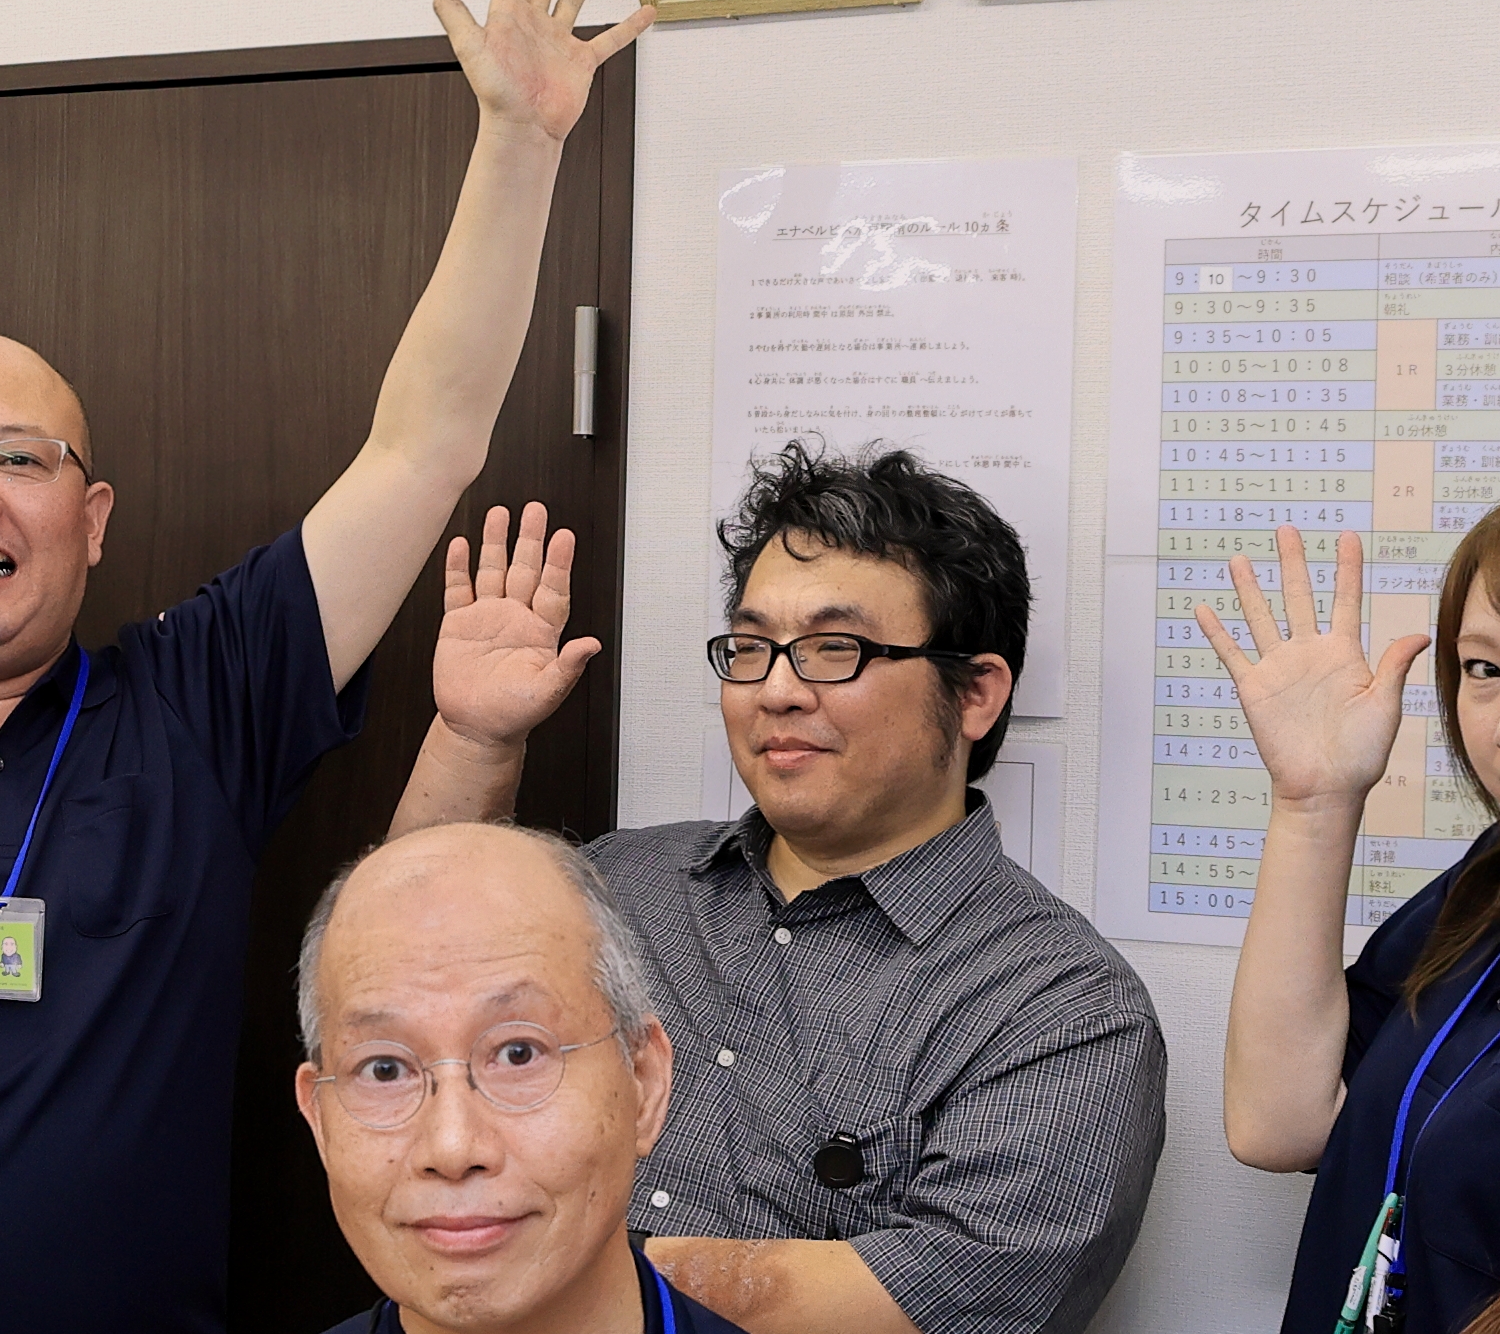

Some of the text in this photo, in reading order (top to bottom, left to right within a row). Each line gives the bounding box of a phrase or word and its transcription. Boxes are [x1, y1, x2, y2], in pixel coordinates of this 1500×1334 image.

[1257, 248, 1283, 261] 時間
[1384, 303, 1411, 316] 朝礼
[1445, 364, 1497, 377] 3分休憩
[1383, 423, 1448, 437] 10分休憩
[1441, 485, 1493, 499] 3分休憩
